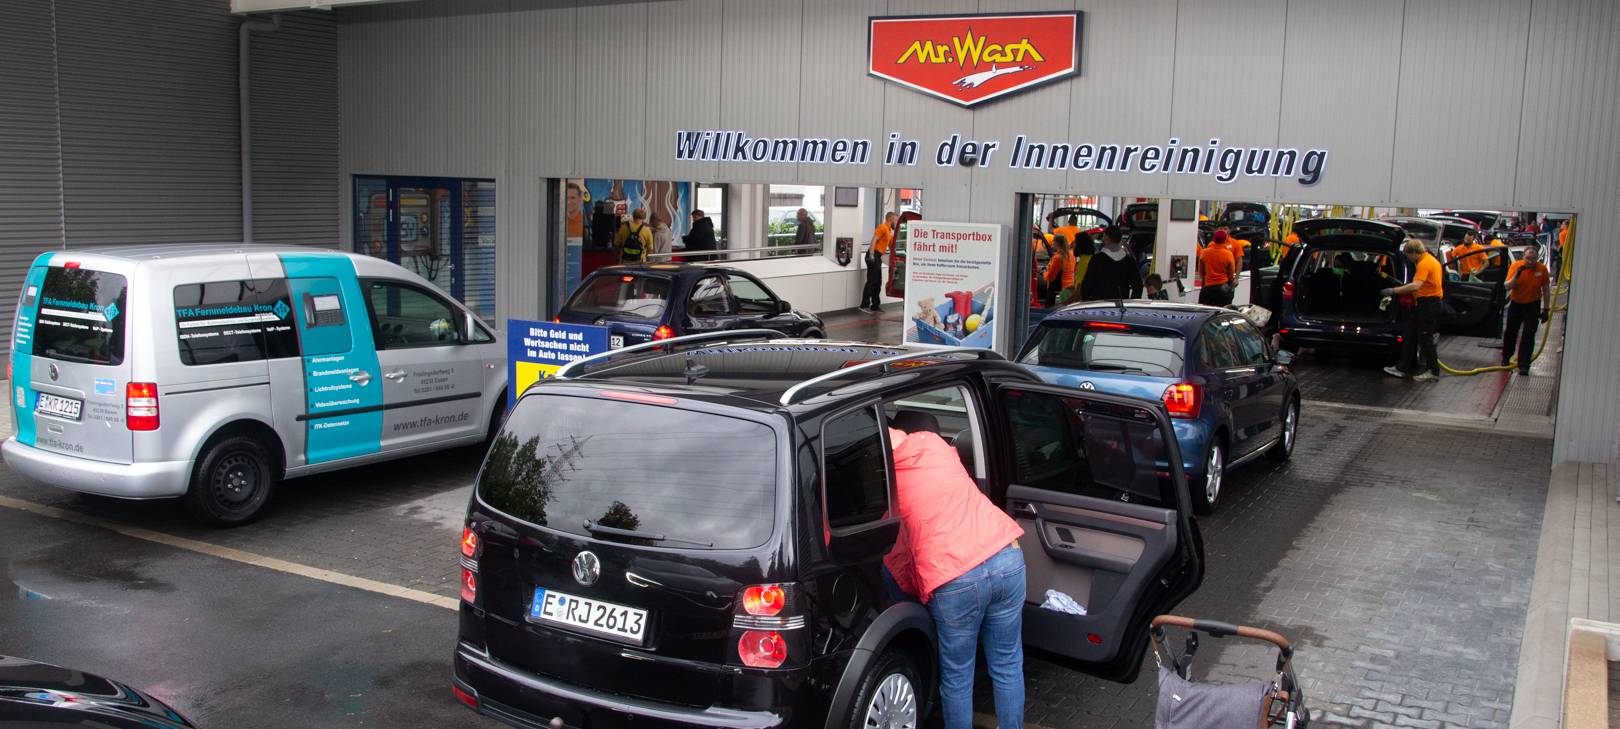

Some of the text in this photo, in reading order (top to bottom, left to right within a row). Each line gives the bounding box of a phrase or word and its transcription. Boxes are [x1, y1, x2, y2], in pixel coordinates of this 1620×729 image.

[675, 130, 1328, 185] Willkommen in der Innenreinigung
[913, 228, 993, 242] Die Transportbox
[913, 241, 958, 254] fährt mit!
[176, 303, 273, 317] TFA Fernmeldebau Kron
[529, 327, 583, 341] Bitte Geld und
[523, 338, 590, 353] Wertsachen nicht
[527, 349, 537, 358] im
[538, 349, 556, 360] Auto
[59, 399, 80, 414] 1215
[393, 410, 470, 432] www.tfa-kron.de
[543, 593, 556, 617] E
